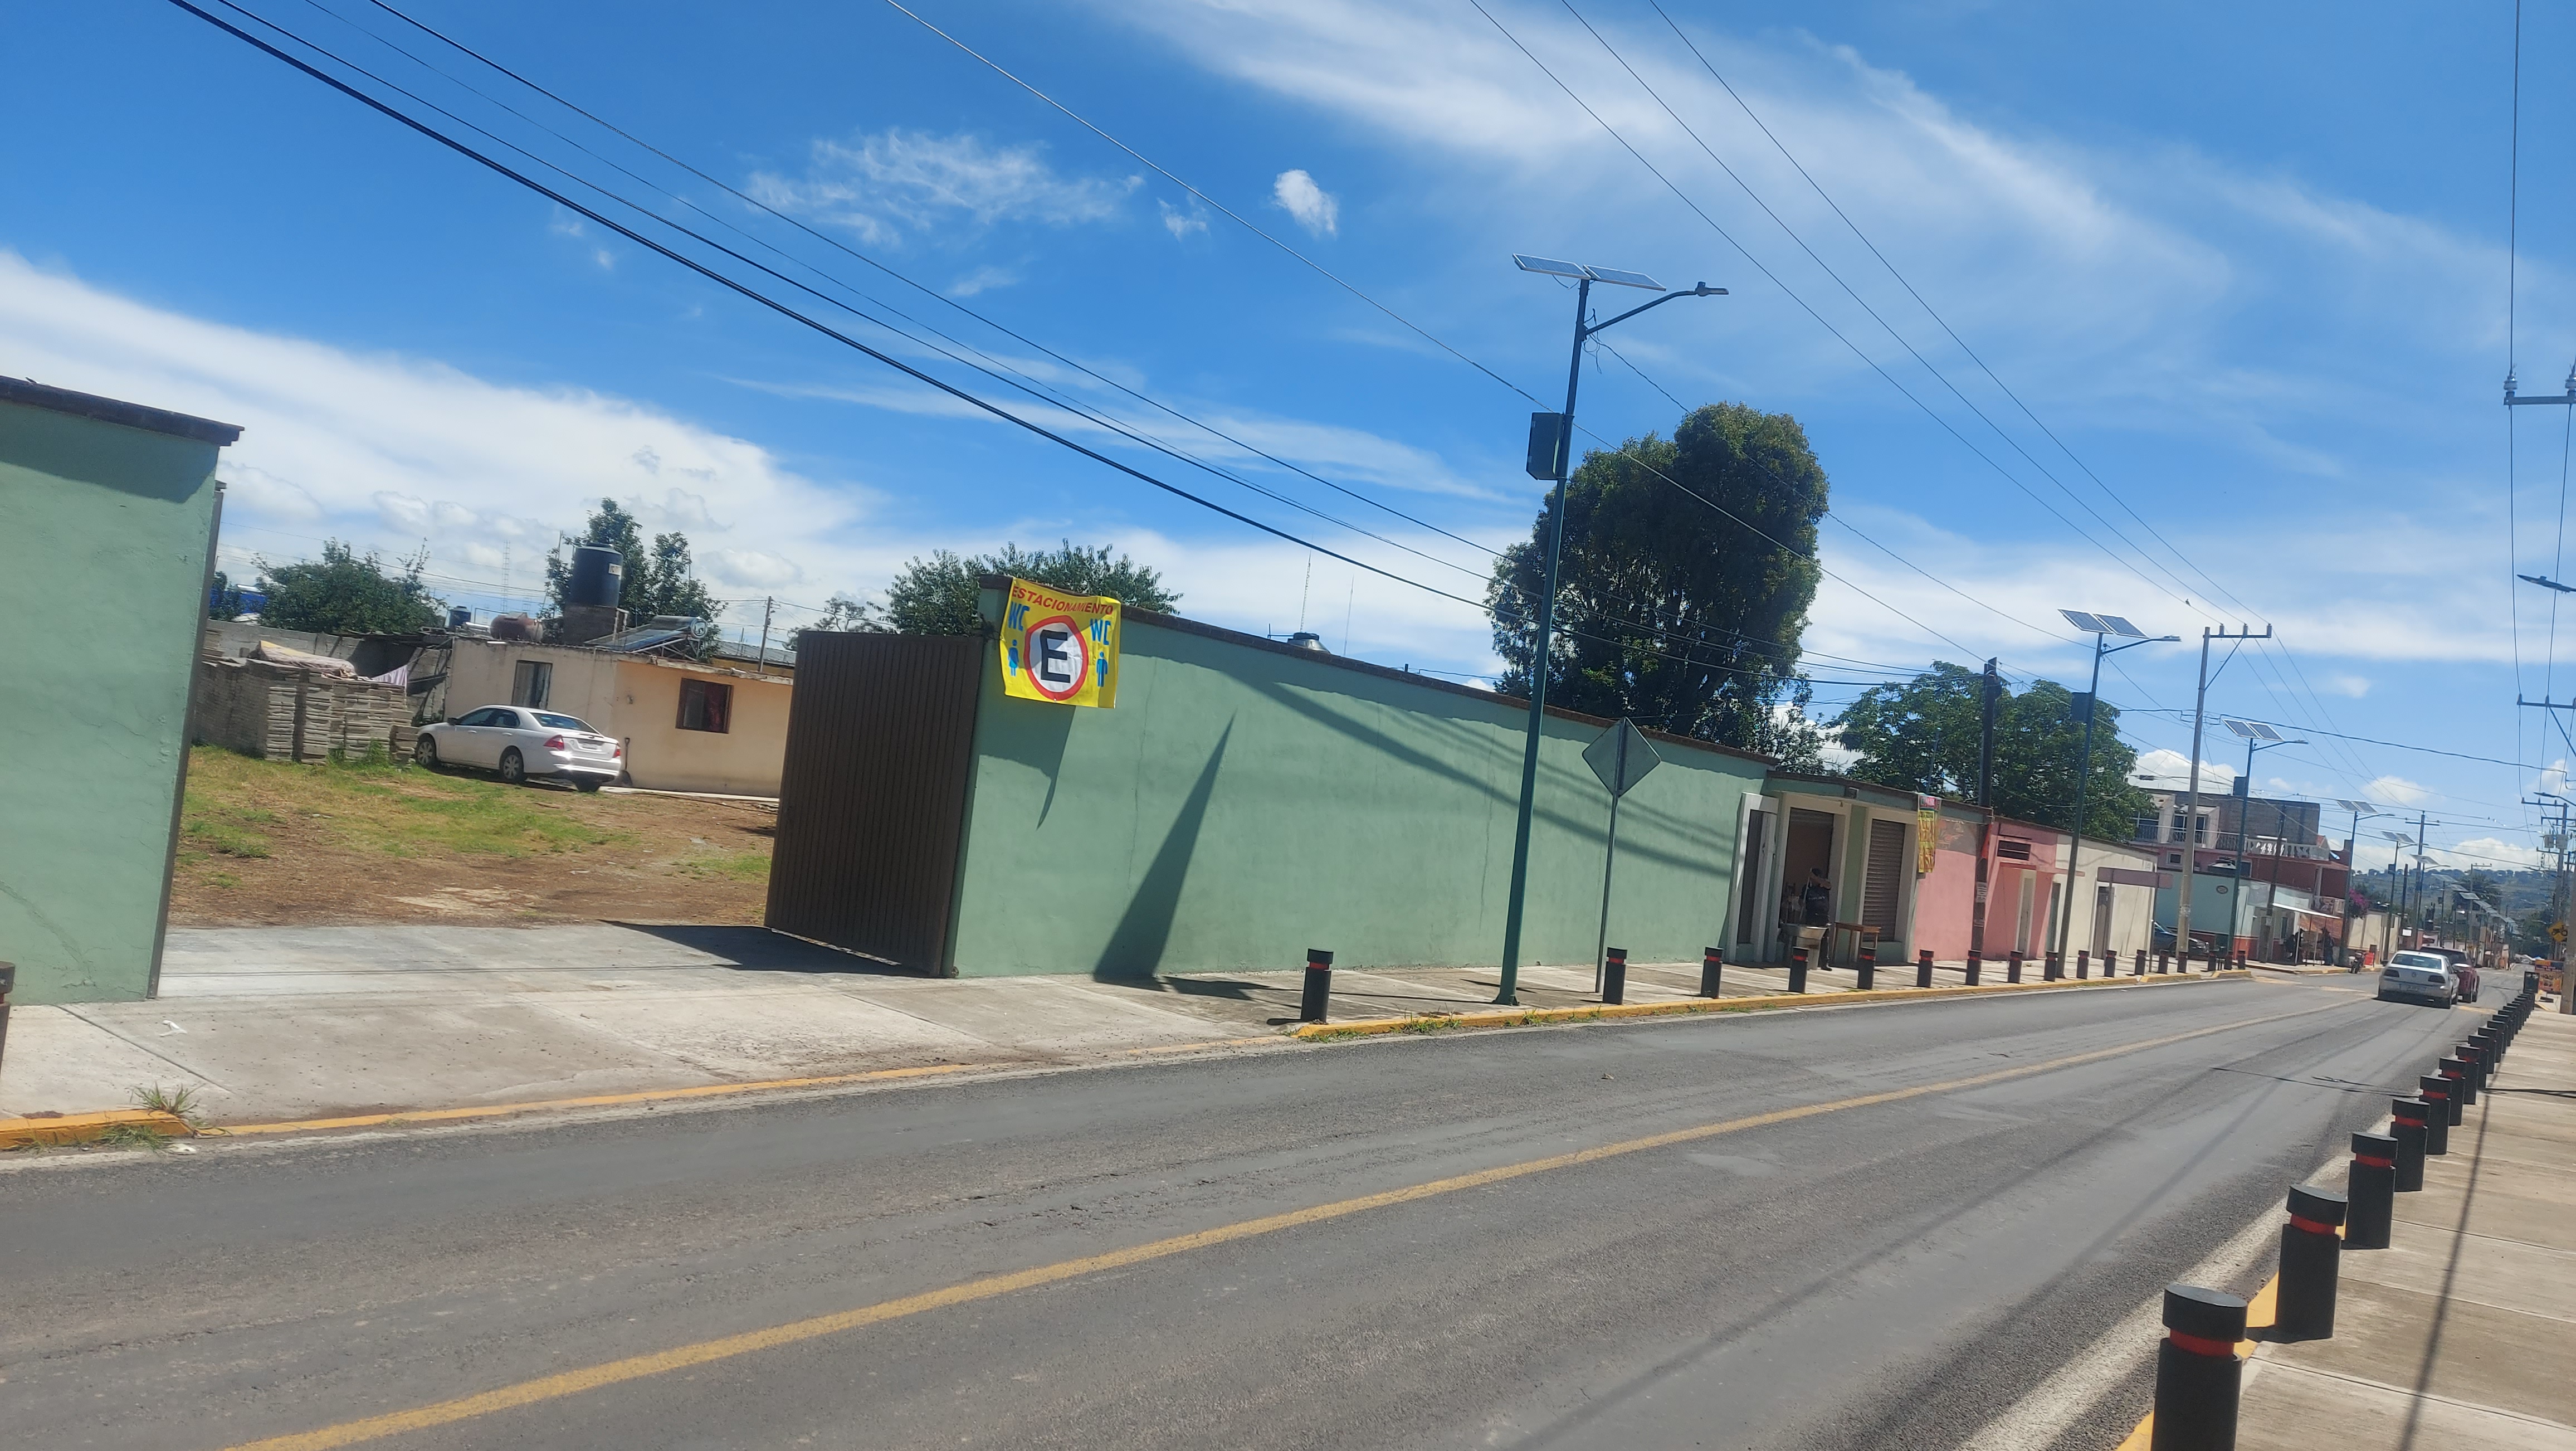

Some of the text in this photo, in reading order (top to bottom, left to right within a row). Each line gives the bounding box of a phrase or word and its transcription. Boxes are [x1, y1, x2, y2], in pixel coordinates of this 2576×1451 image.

[1012, 586, 1113, 615] ESTACIONAMIENTO
[1008, 601, 1030, 631] WC
[1090, 618, 1111, 645] WC
[1040, 629, 1070, 684] E
